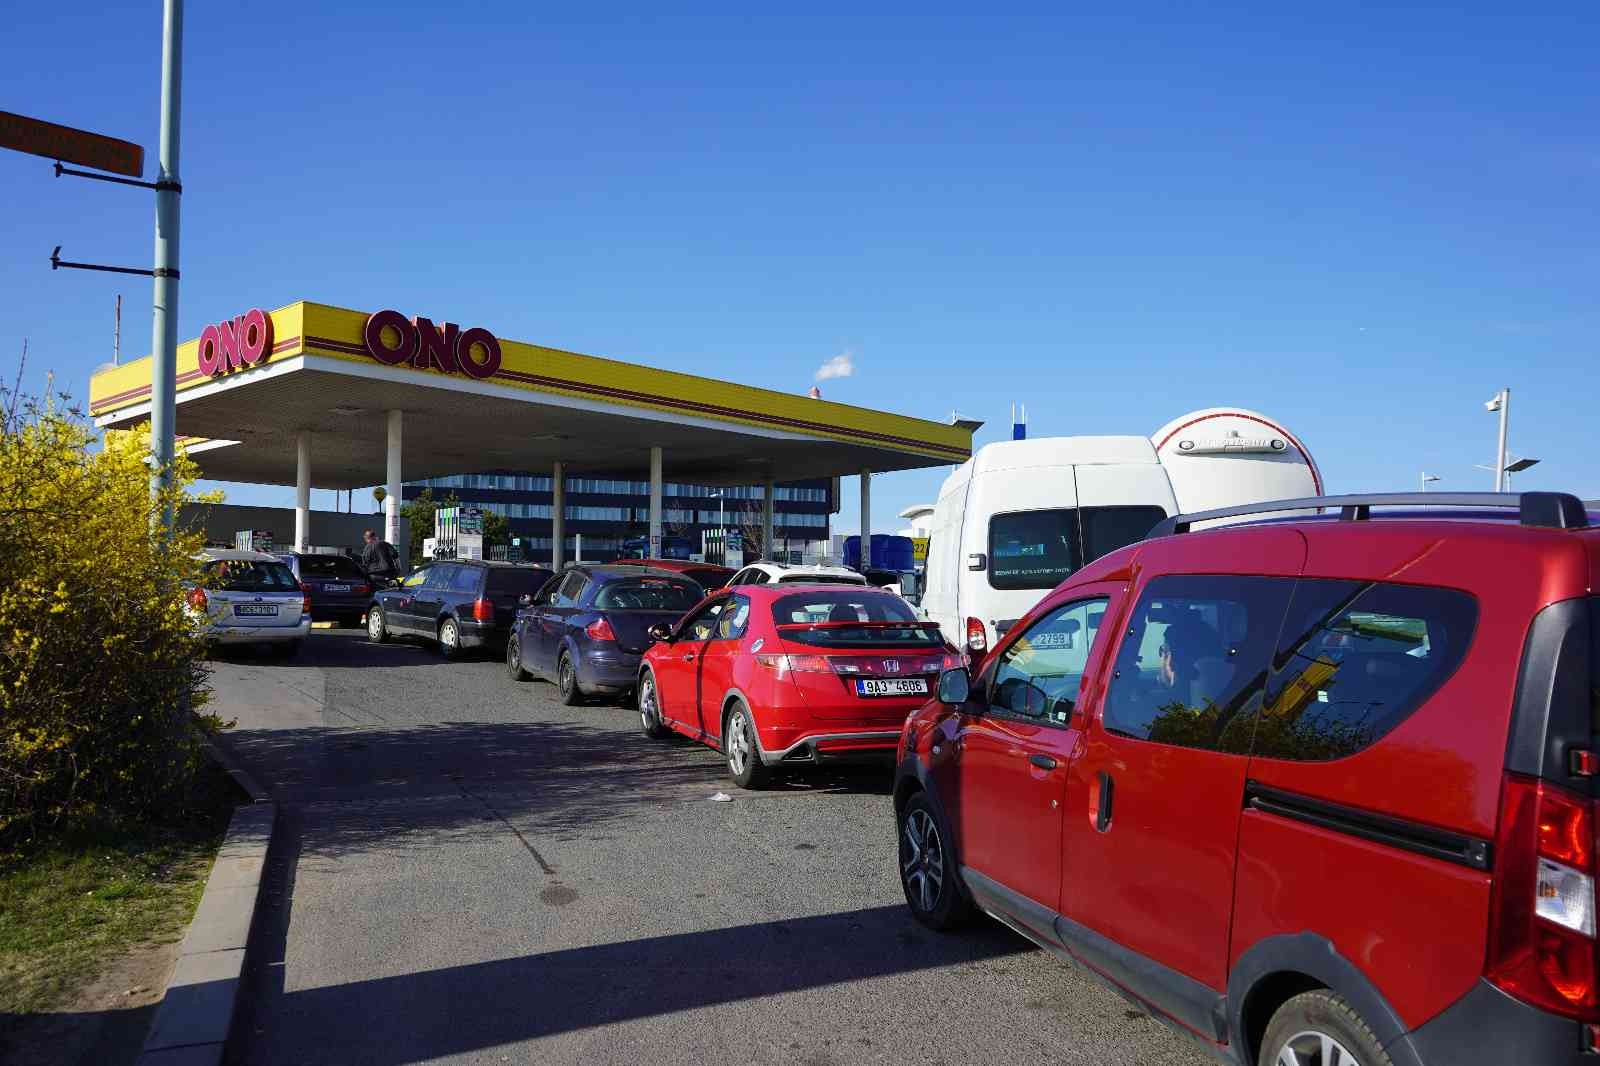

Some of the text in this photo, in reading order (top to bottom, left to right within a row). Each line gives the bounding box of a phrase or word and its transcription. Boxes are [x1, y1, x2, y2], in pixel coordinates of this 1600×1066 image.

[198, 307, 272, 377] ONO
[366, 310, 501, 378] ONO
[867, 681, 921, 693] 9A3 4606
